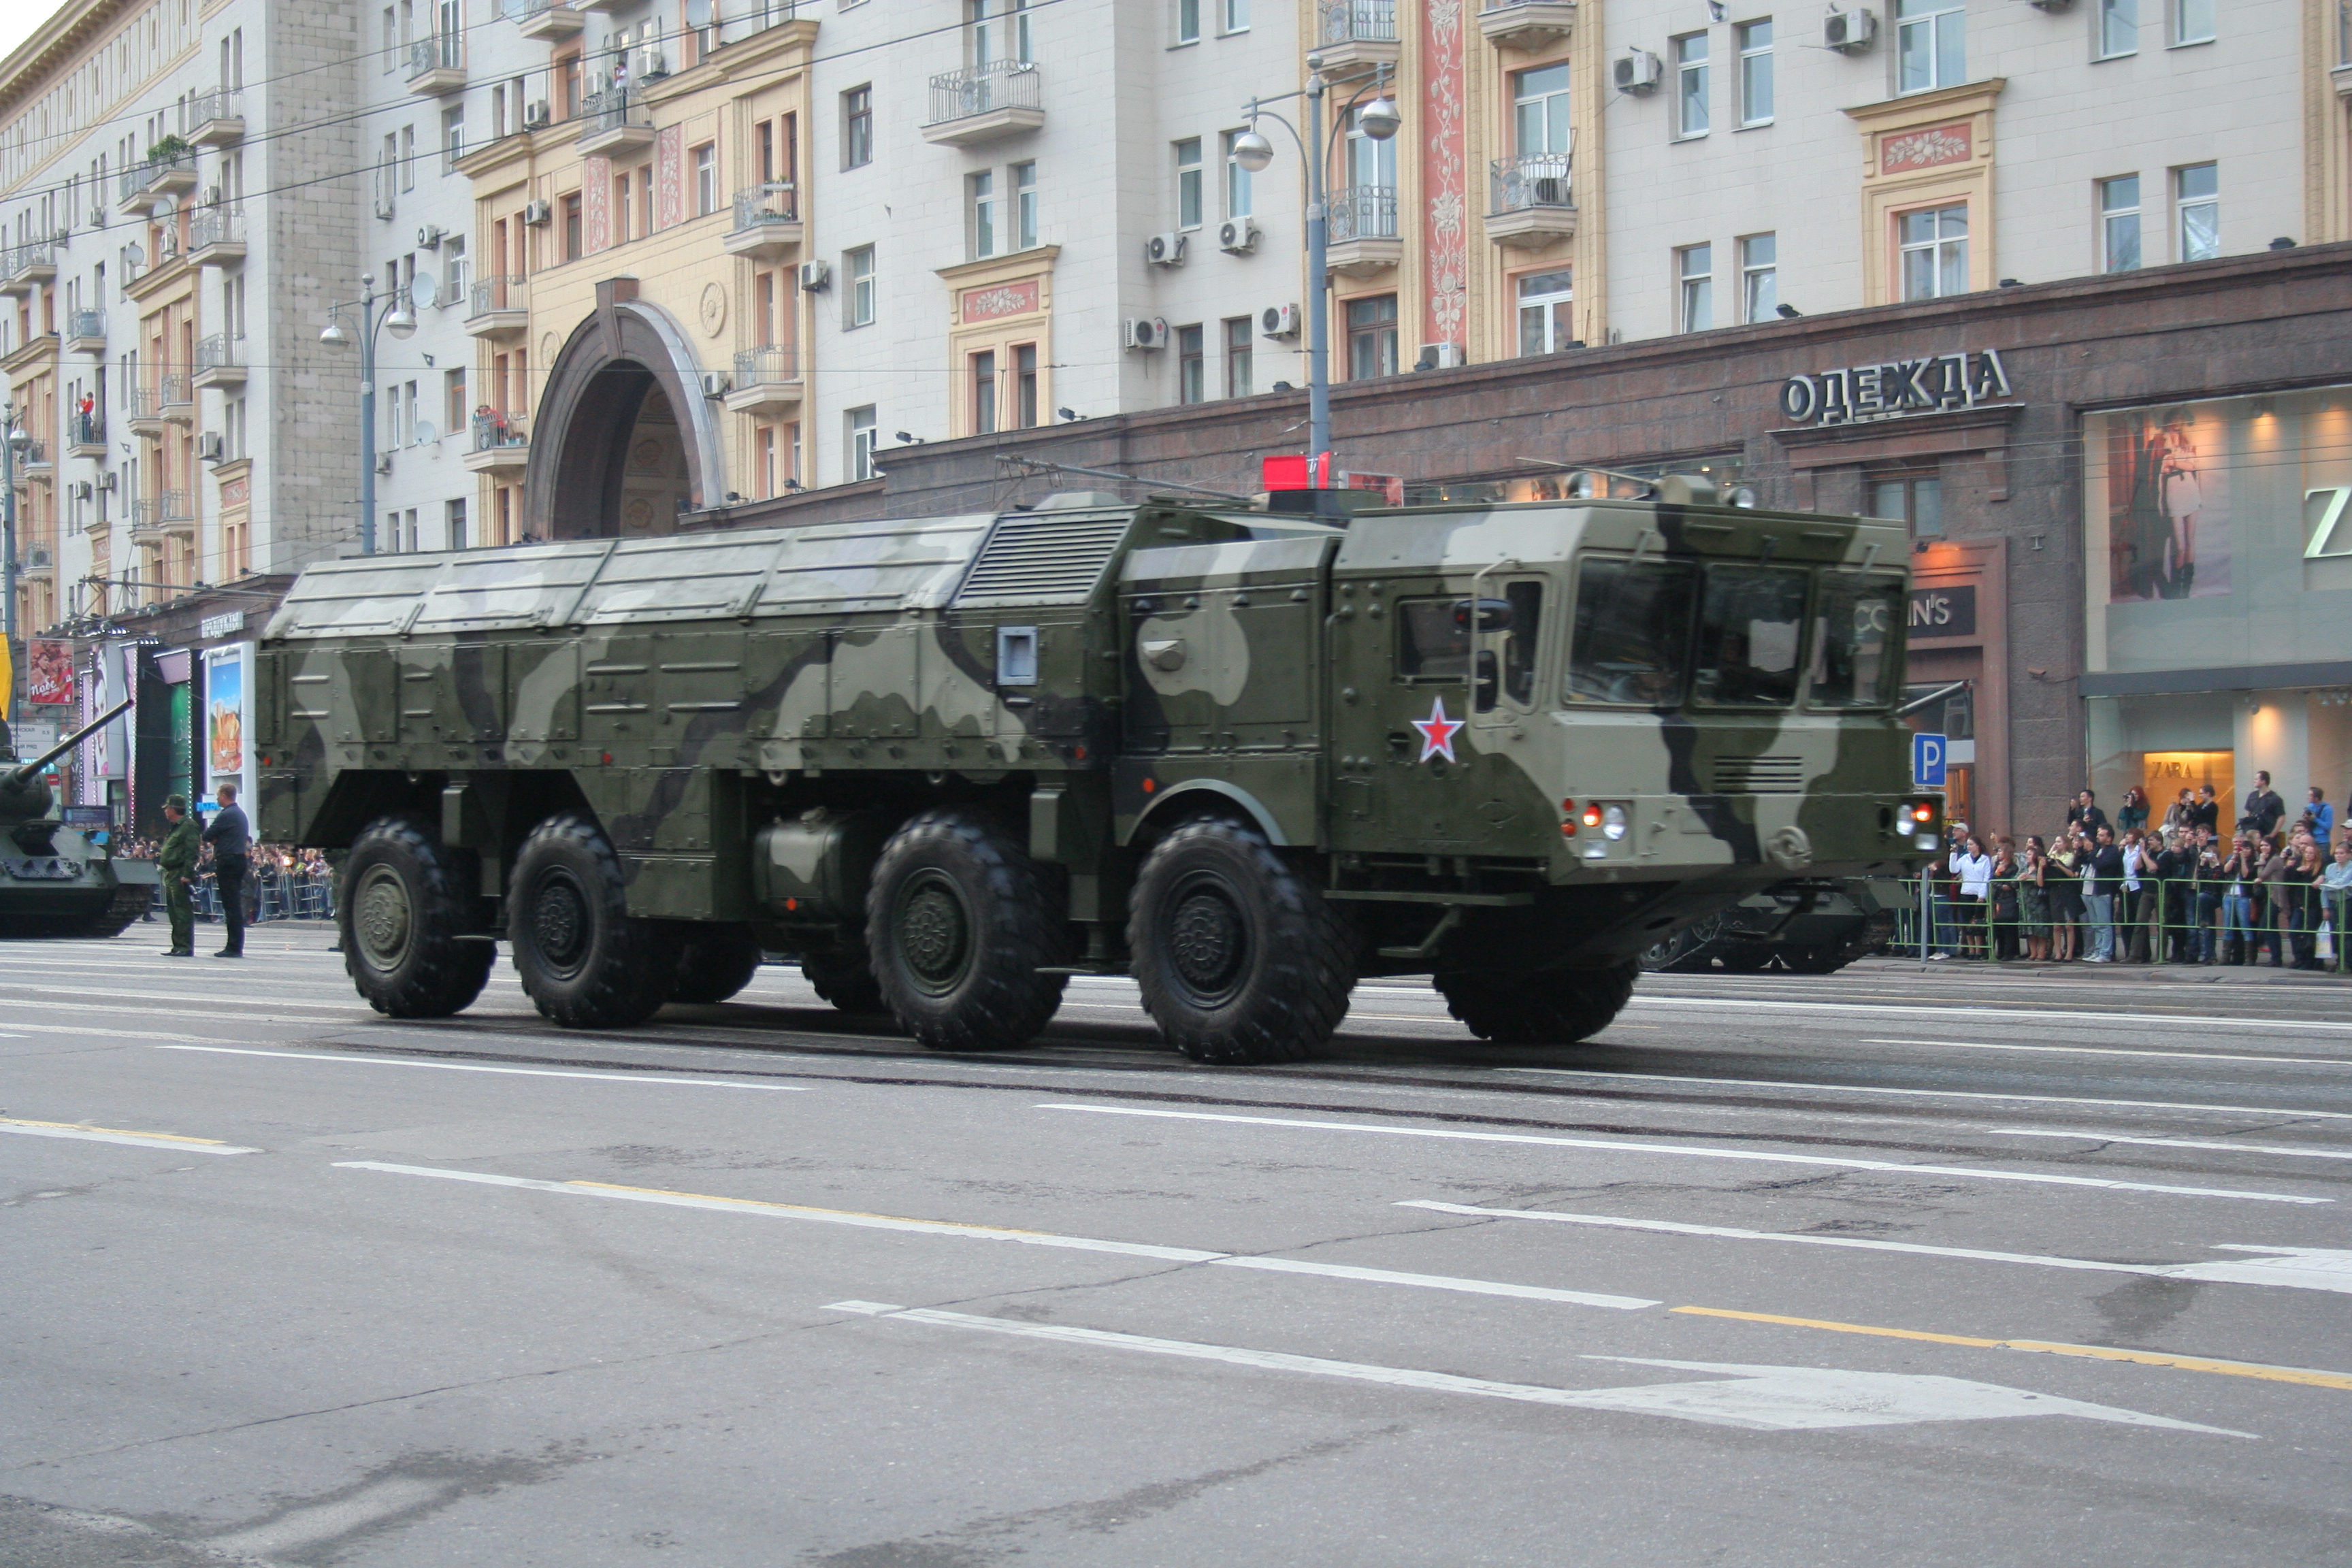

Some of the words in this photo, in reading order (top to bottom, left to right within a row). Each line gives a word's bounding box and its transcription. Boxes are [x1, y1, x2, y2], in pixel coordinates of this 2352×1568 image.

[1780, 348, 2012, 427] ОДЕЖДА
[1853, 593, 1950, 633] COIN'S
[31, 674, 74, 696] Побеа
[1923, 740, 1940, 781] P
[2151, 762, 2193, 778] ZARA
